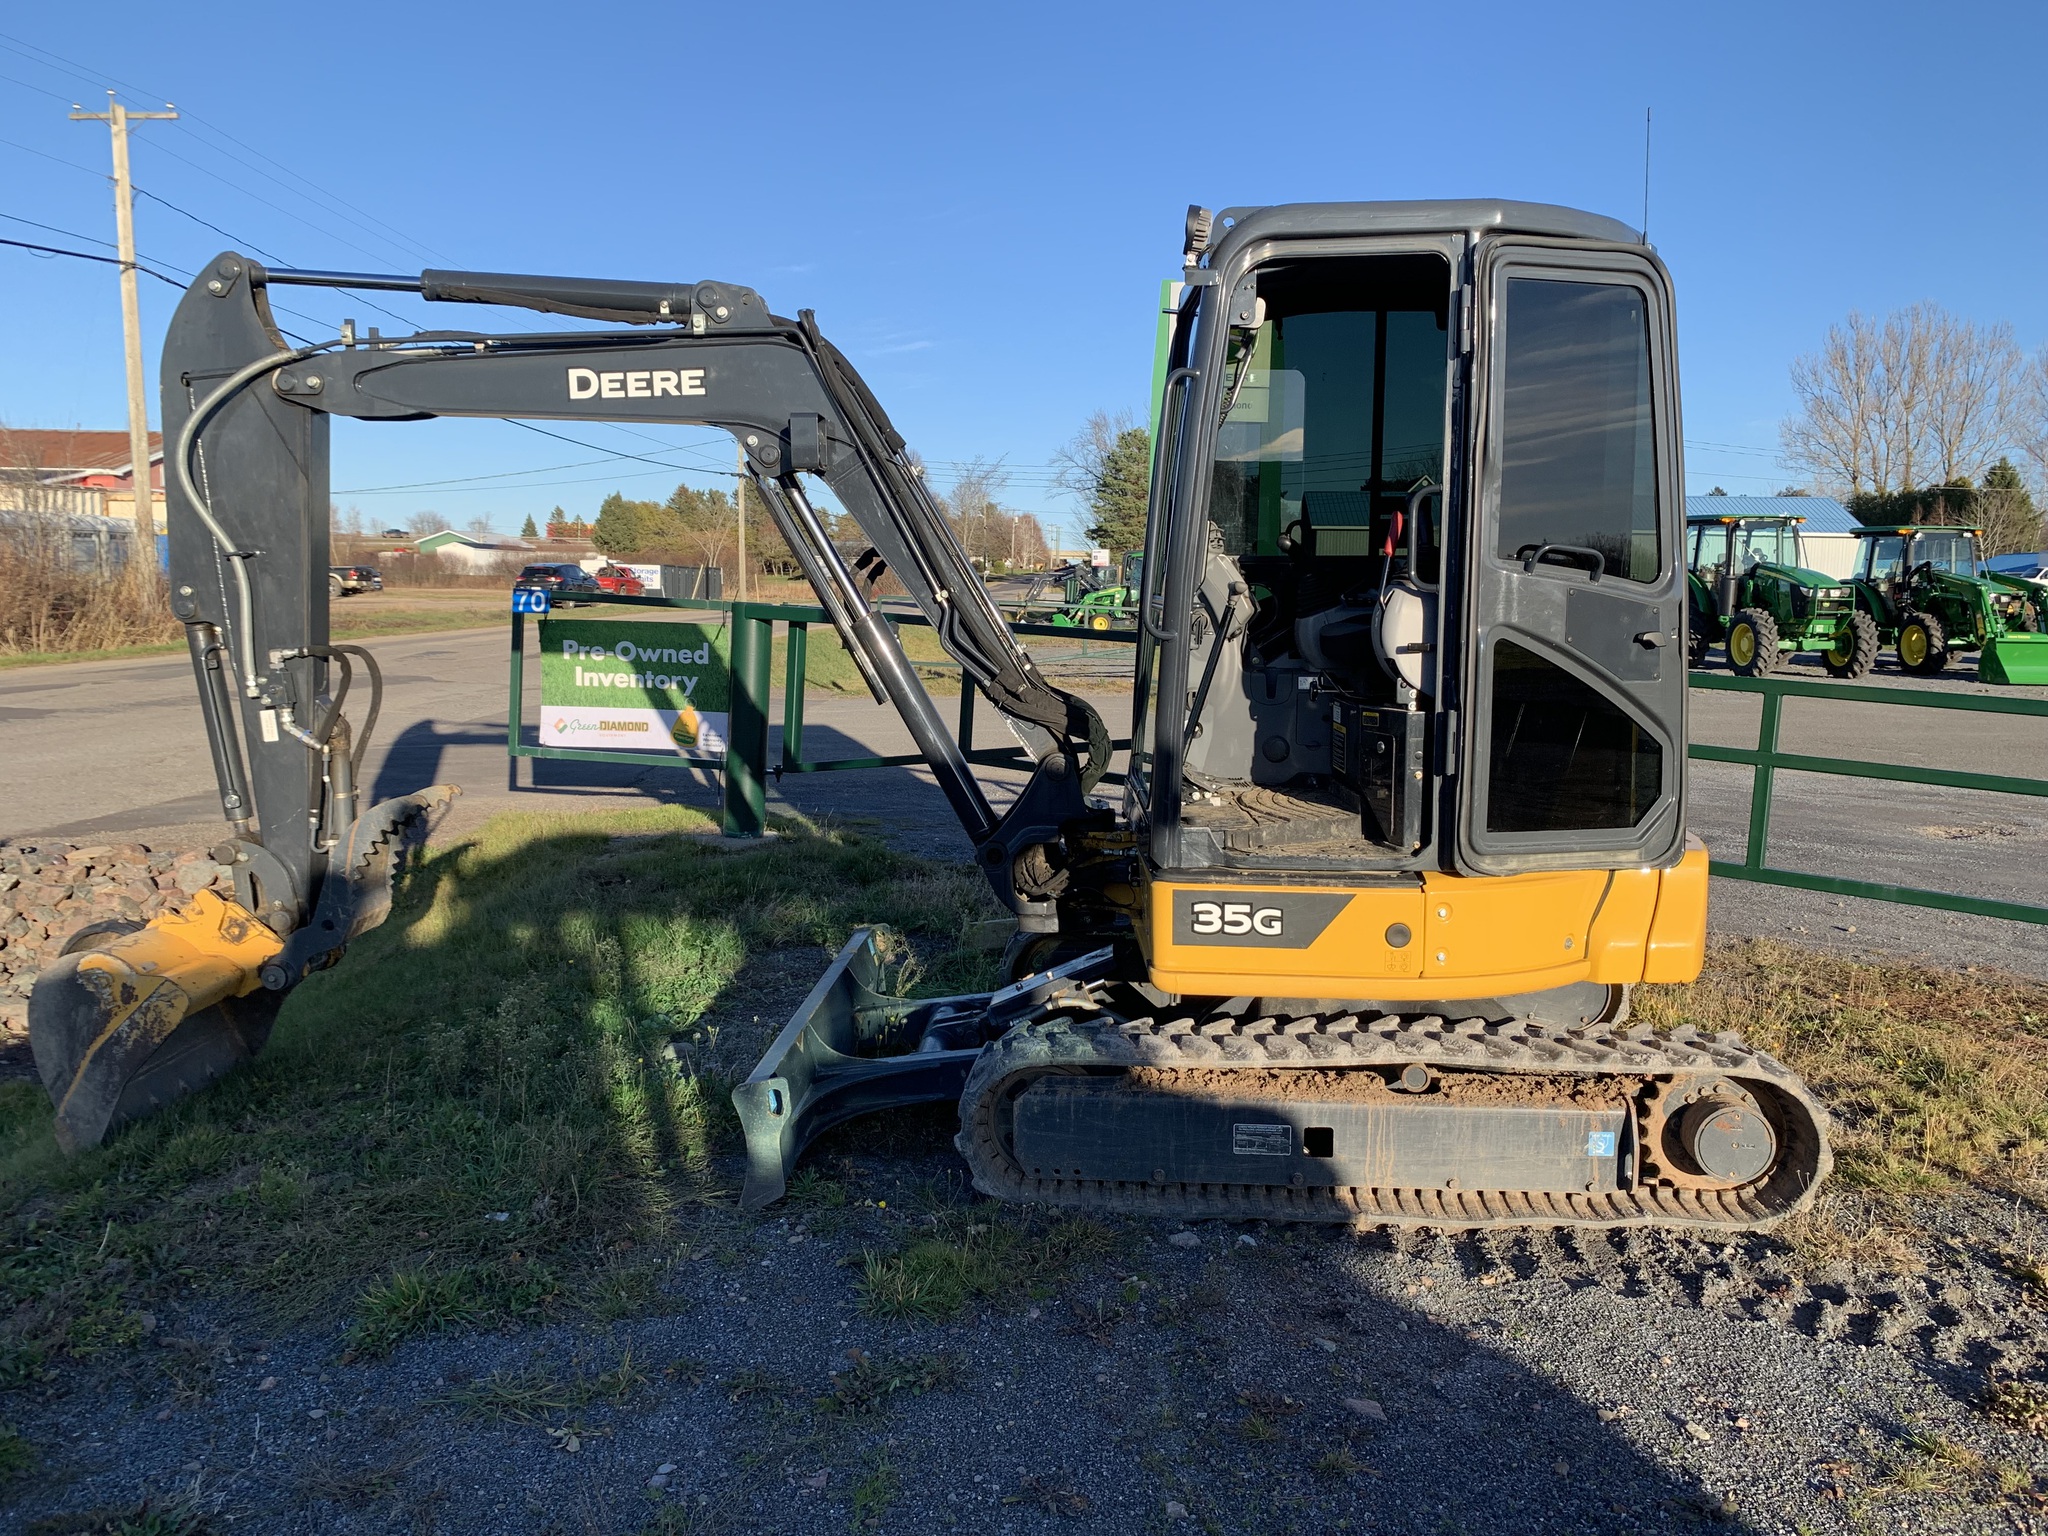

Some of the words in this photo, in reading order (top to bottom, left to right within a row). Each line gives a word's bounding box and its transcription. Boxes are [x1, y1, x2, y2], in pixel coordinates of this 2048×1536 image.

[568, 368, 706, 400] DEERE
[630, 566, 659, 576] torage
[514, 591, 546, 613] 70
[562, 639, 709, 665] Pre-Owned
[575, 666, 699, 697] Inventory
[1192, 901, 1283, 936] 35G
